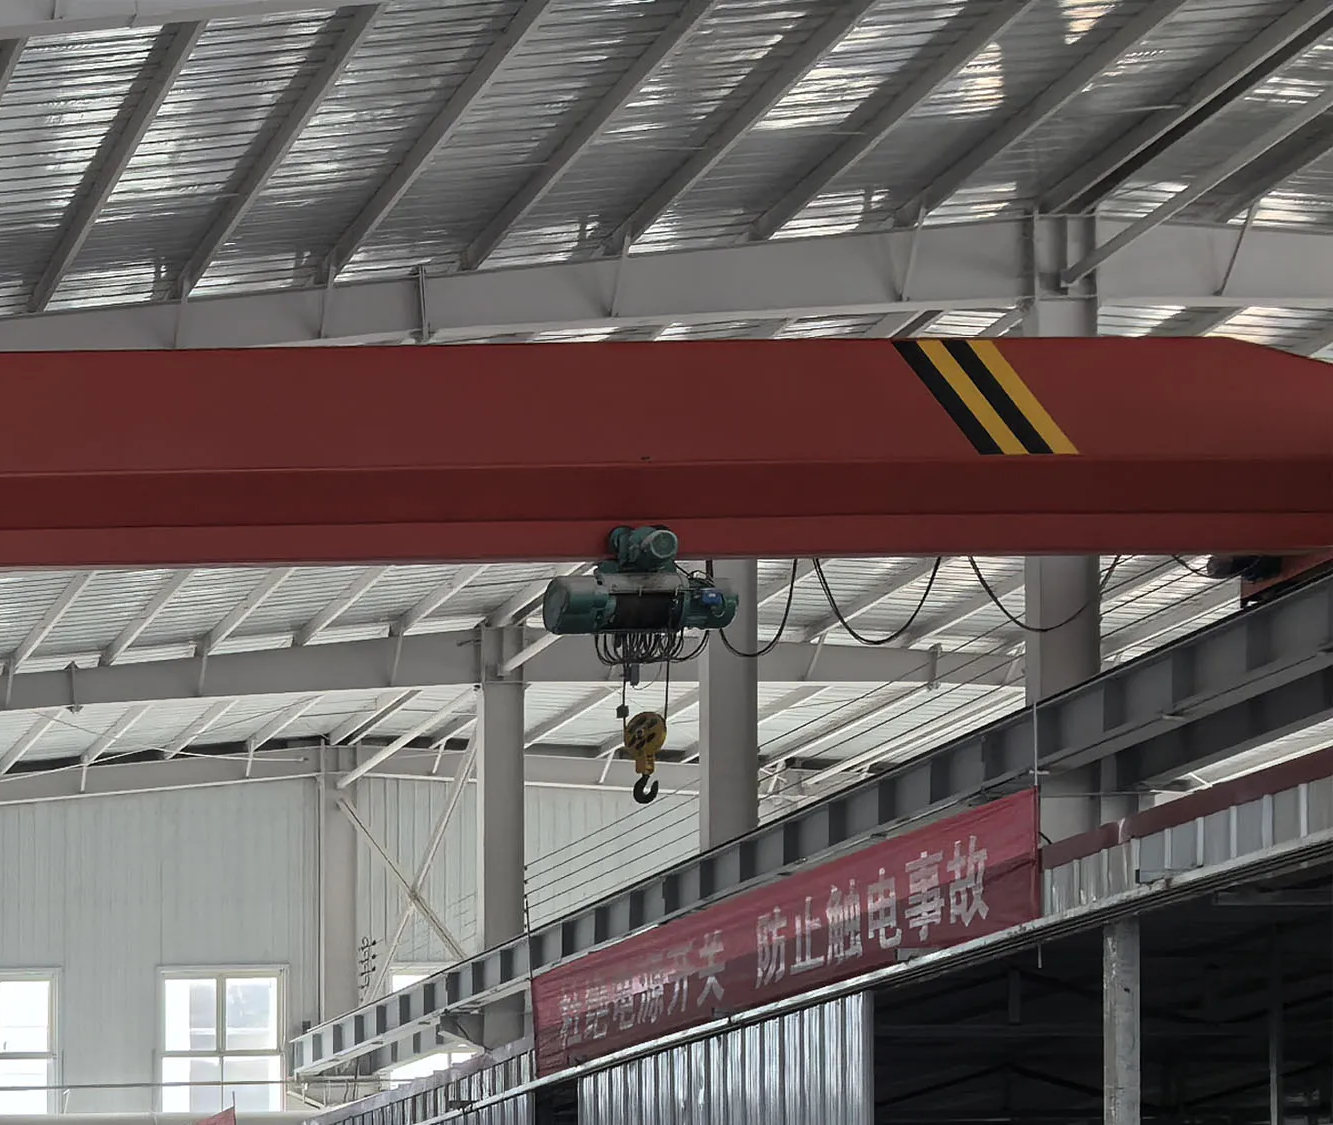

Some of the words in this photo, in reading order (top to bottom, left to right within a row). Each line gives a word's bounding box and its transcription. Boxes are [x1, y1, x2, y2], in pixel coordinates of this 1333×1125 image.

[755, 835, 989, 989] 防止触电事故
